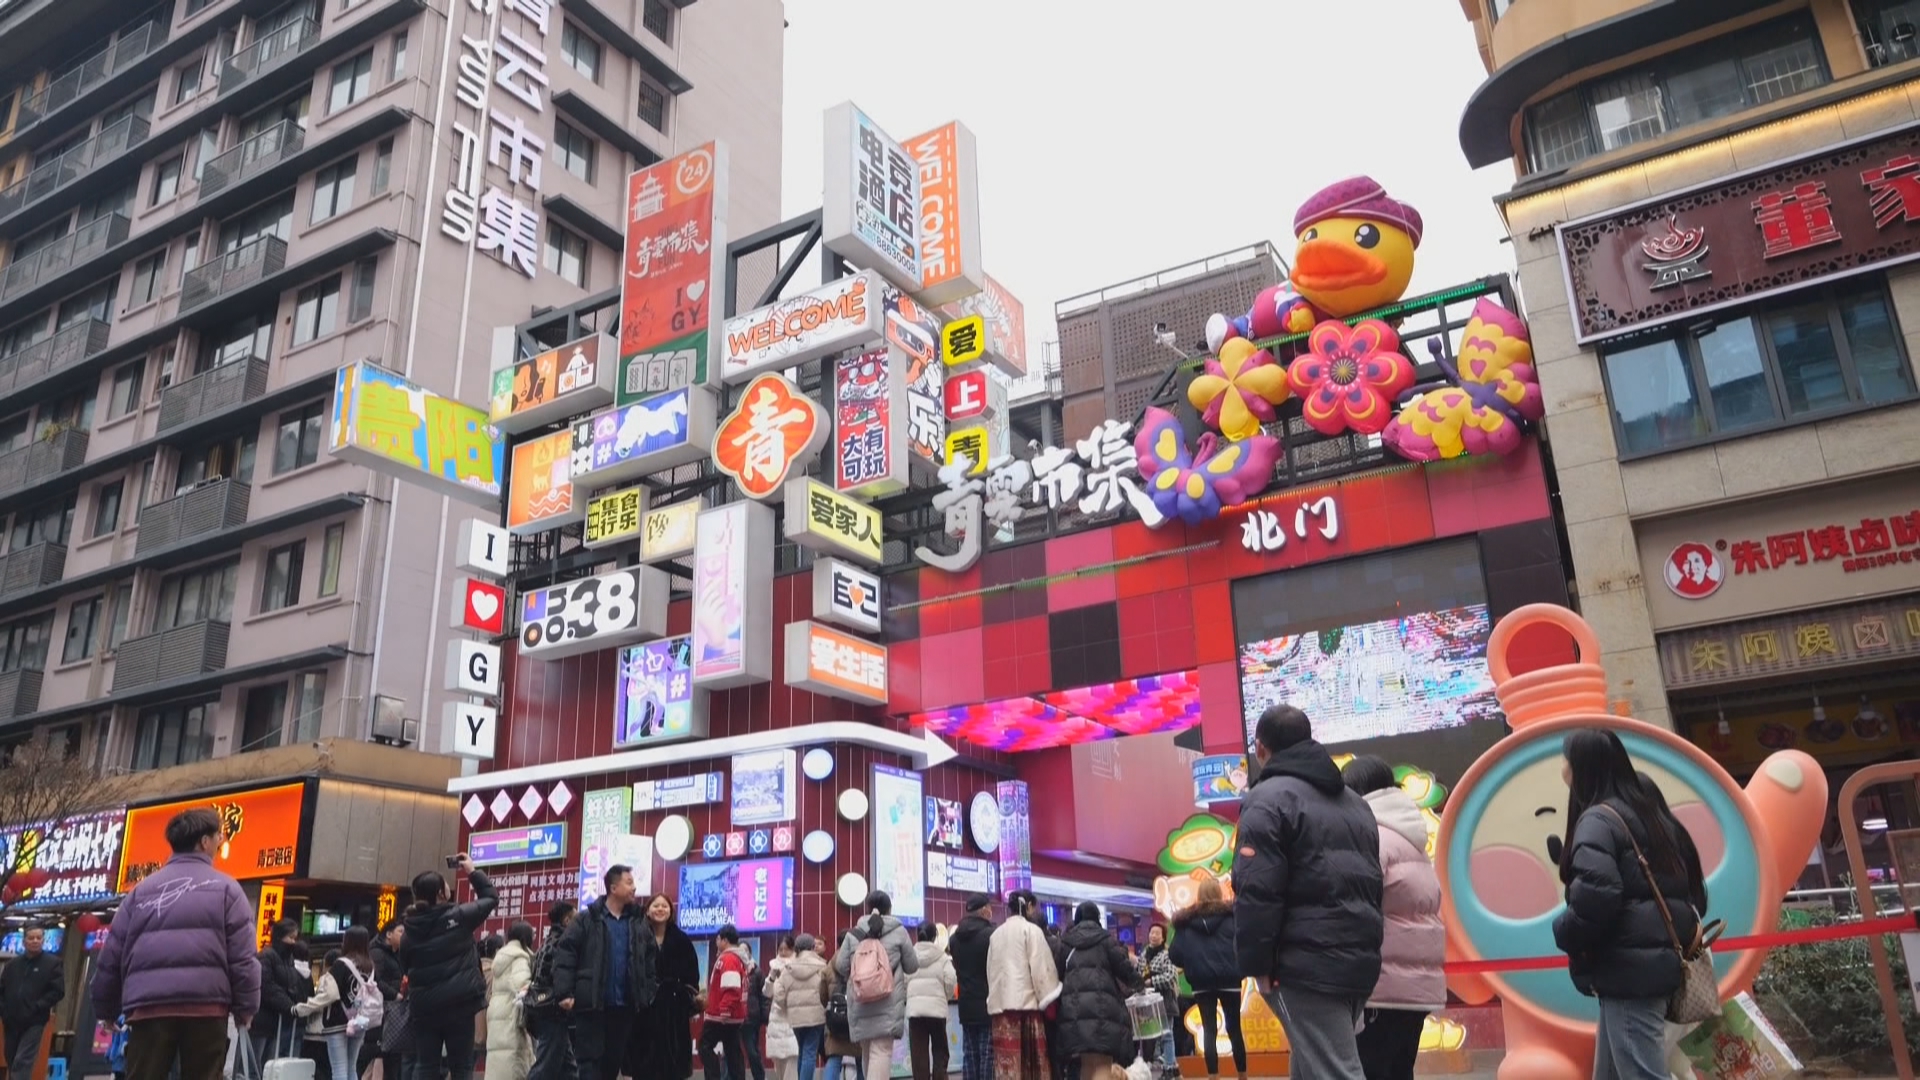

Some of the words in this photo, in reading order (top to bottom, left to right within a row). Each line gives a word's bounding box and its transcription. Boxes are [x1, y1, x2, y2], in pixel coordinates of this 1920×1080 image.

[684, 161, 704, 183] 24
[916, 133, 947, 287] WELCOME
[728, 288, 866, 357] WELCOME
[731, 387, 807, 482] 青
[811, 490, 880, 549] 爱家人
[1240, 496, 1338, 552] 北门
[484, 533, 495, 561] I
[680, 917, 715, 928] WORKING
[715, 915, 737, 925] MEAL
[681, 908, 708, 918] FAMILY
[708, 906, 728, 916] MEAL
[1247, 1033, 1281, 1050] 025
